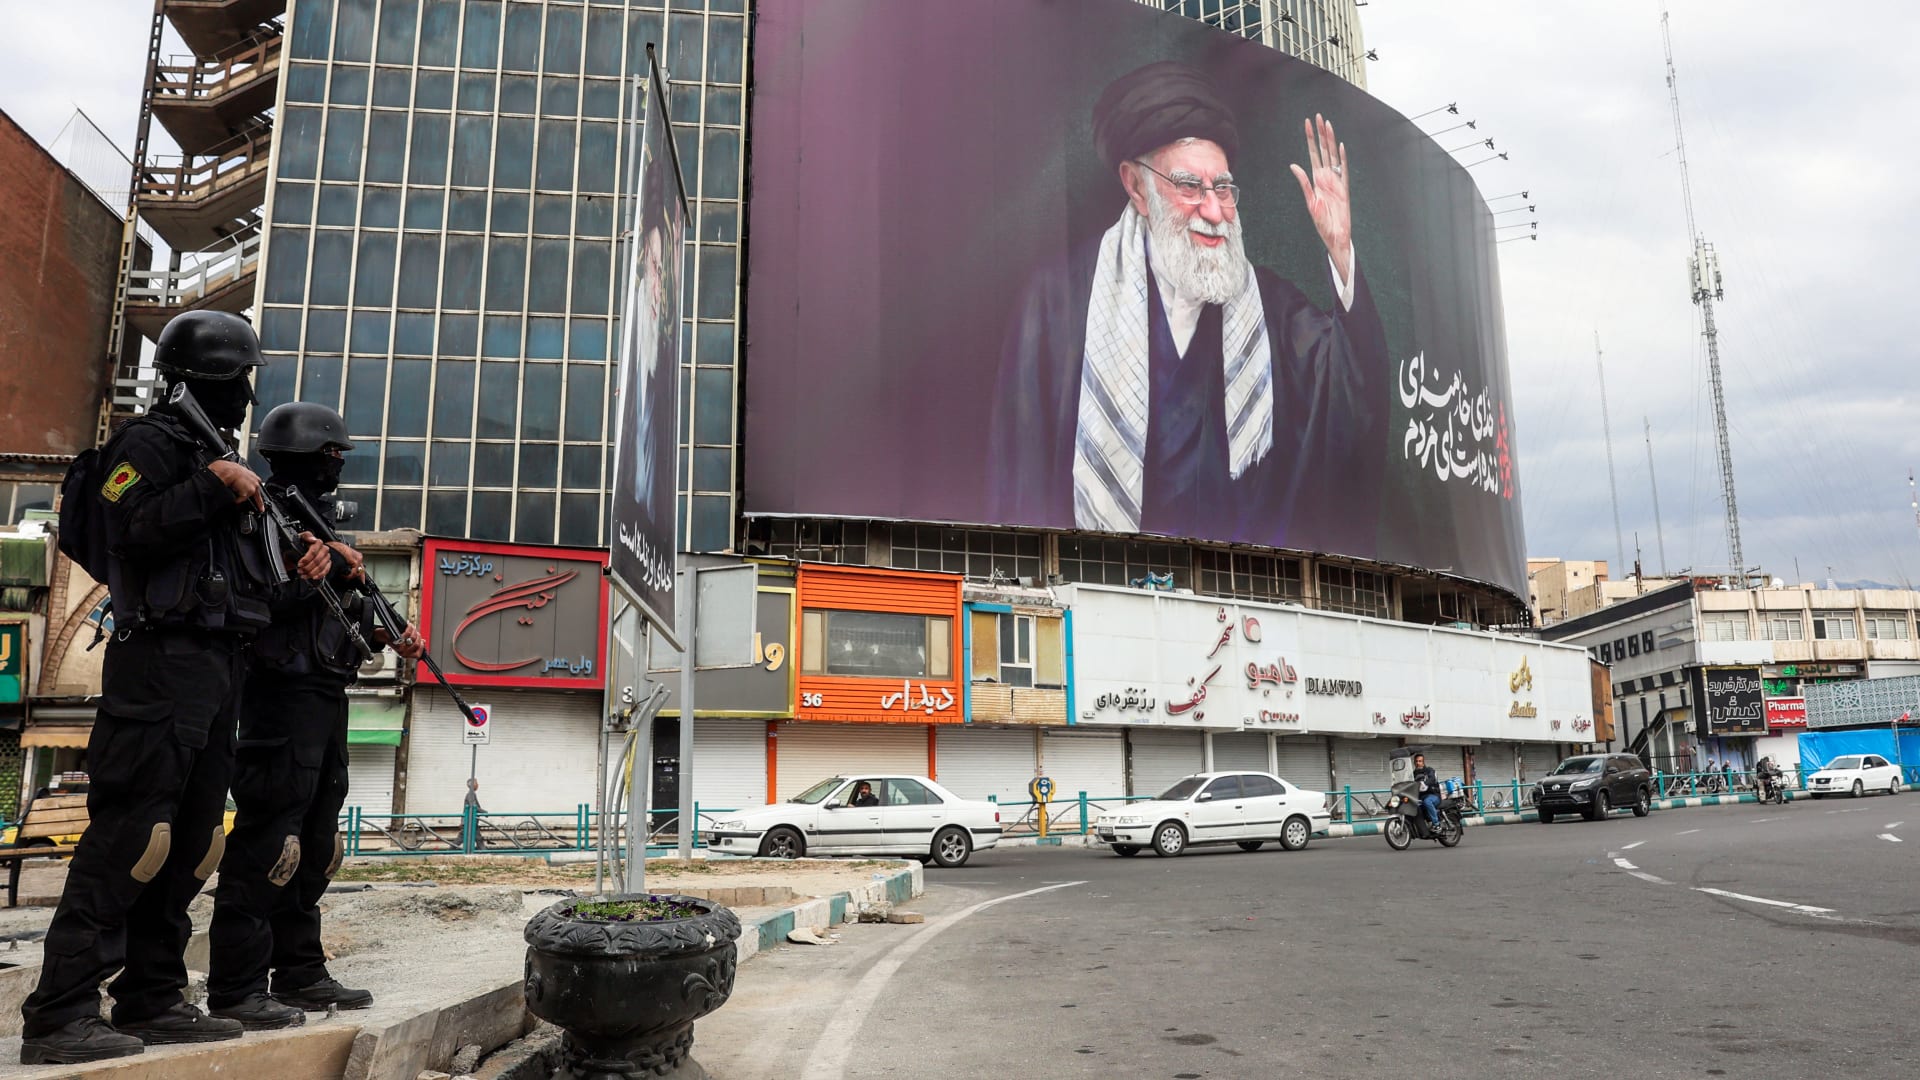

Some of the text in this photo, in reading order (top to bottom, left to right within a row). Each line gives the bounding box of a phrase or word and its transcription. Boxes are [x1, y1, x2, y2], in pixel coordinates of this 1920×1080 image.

[1405, 412, 1438, 469] مردم
[440, 555, 493, 576] مرکز خرید
[1709, 676, 1735, 696] خرید
[1735, 676, 1760, 693] مرکز
[802, 693, 823, 707] 36
[1768, 701, 1804, 711] Pharma
[1712, 696, 1760, 725] کیش
